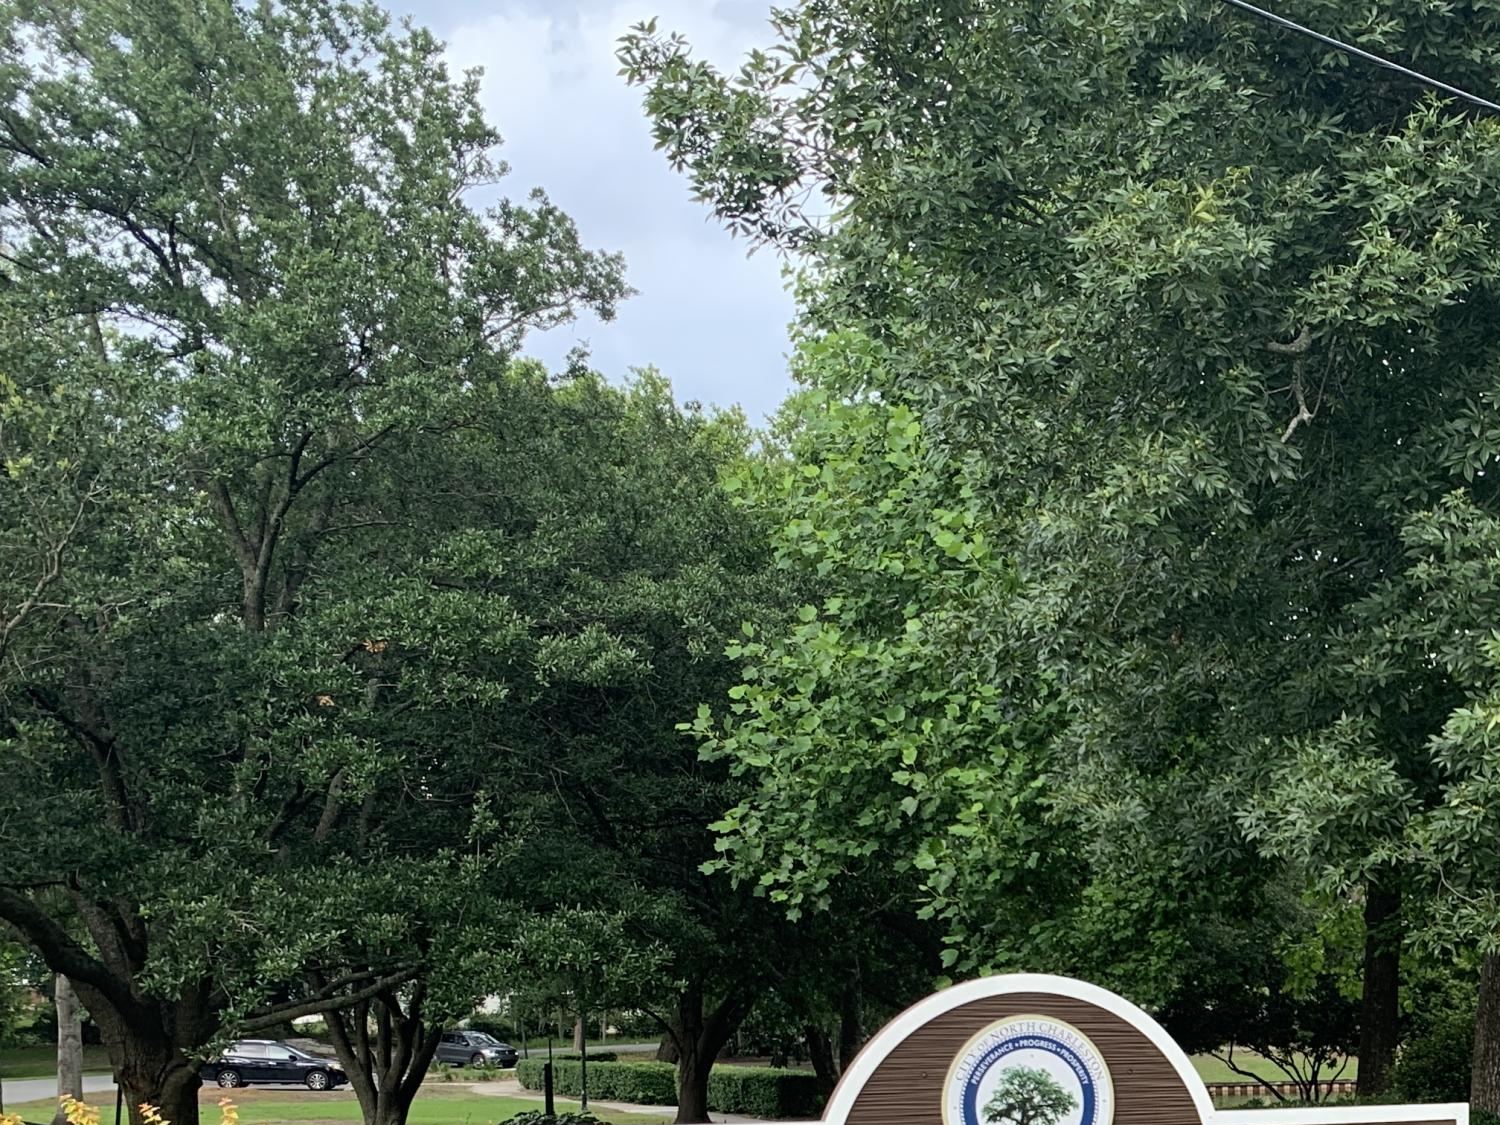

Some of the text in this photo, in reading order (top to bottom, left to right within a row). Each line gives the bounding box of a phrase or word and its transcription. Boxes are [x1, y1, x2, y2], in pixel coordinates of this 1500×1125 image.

[956, 1049, 977, 1081] CITY
[990, 1022, 1035, 1040] NORTH
[1039, 1022, 1103, 1080] CHARLESTON
[971, 1039, 1090, 1085] PERSEVERANCE PROGRESS PROSPERITY
